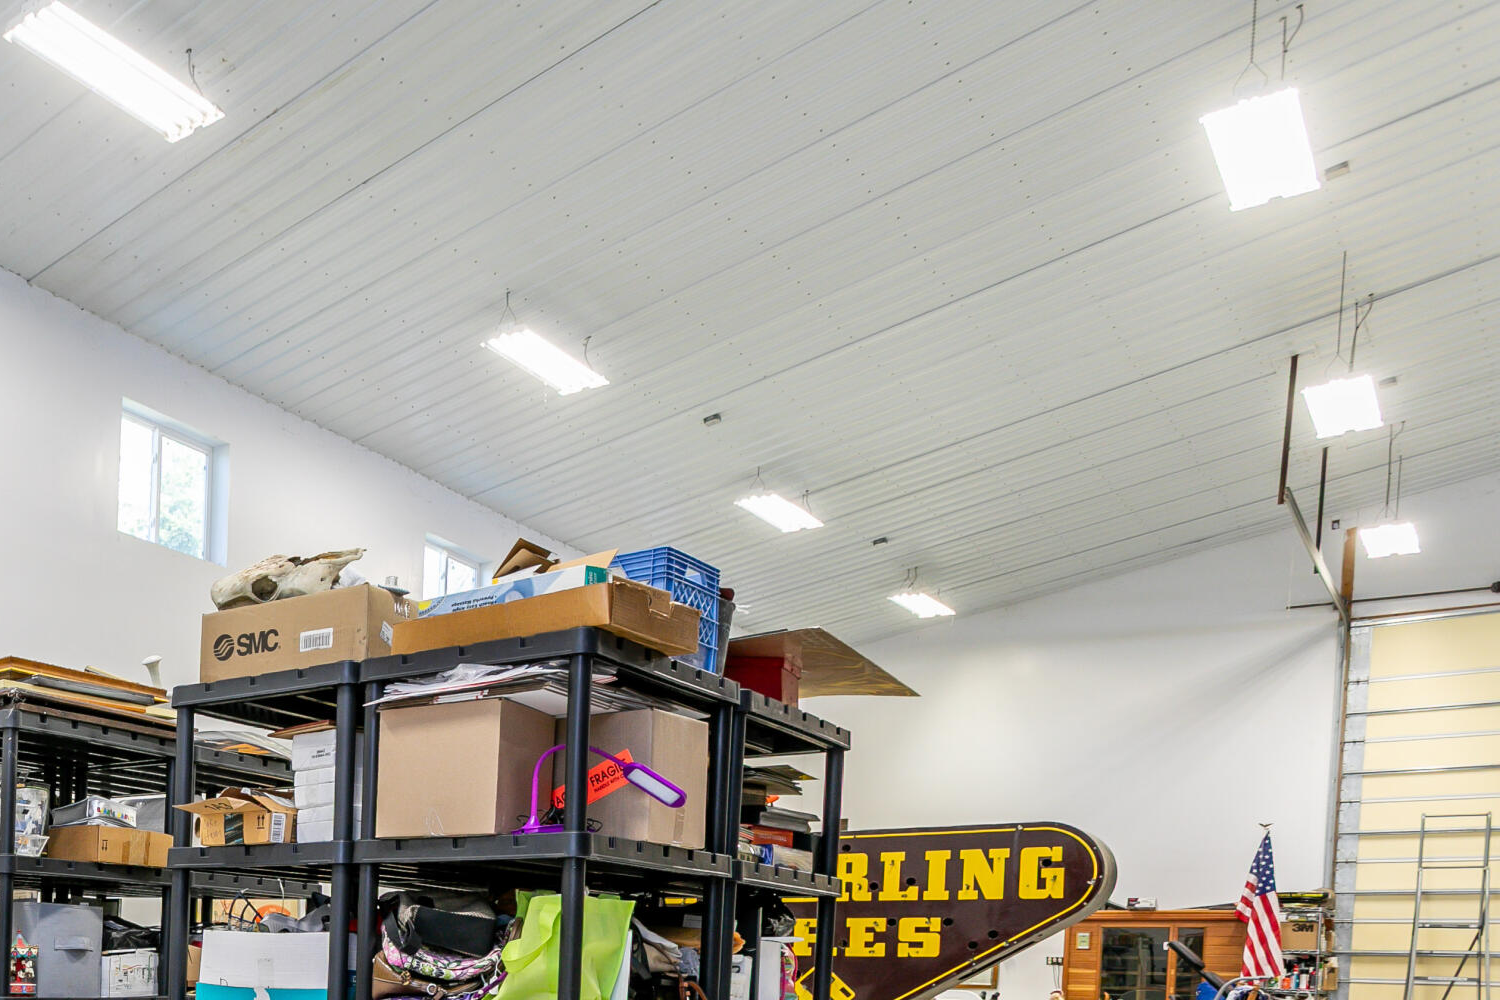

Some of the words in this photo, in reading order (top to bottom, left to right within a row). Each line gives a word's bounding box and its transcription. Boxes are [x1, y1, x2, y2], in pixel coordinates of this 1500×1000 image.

[237, 628, 279, 657] SMC
[589, 757, 626, 788] FRAGIL
[836, 846, 1065, 902] RLING
[1292, 924, 1314, 932] 3M
